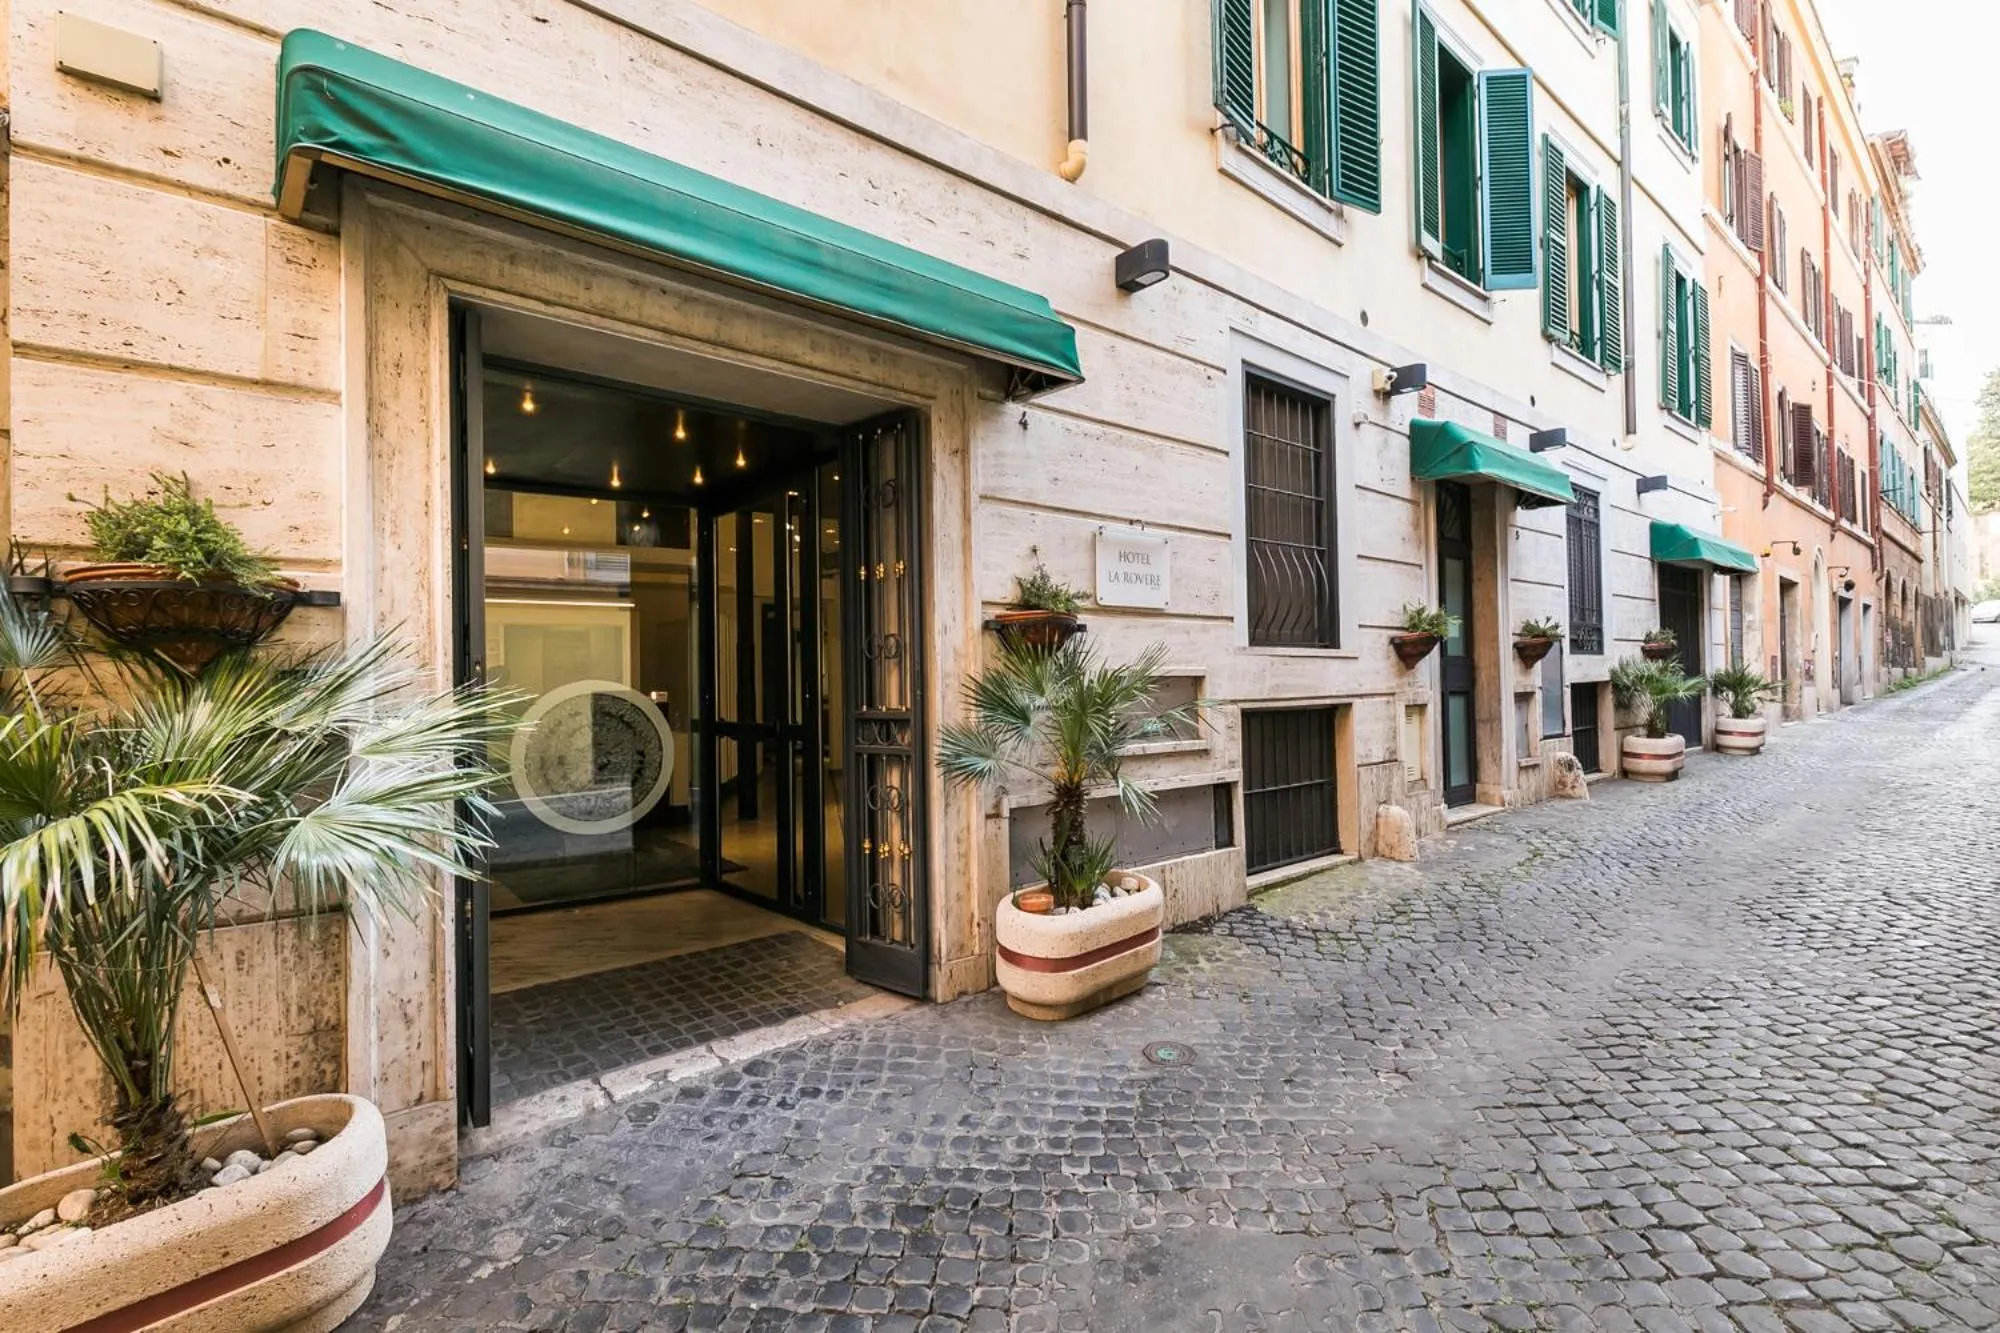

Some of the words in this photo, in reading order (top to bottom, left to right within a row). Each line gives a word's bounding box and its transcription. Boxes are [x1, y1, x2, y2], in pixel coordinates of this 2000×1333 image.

[1018, 410, 1029, 431] 4
[1118, 550, 1152, 566] HOTEL
[1108, 570, 1121, 584] LA
[1123, 571, 1161, 586] ROVERE
